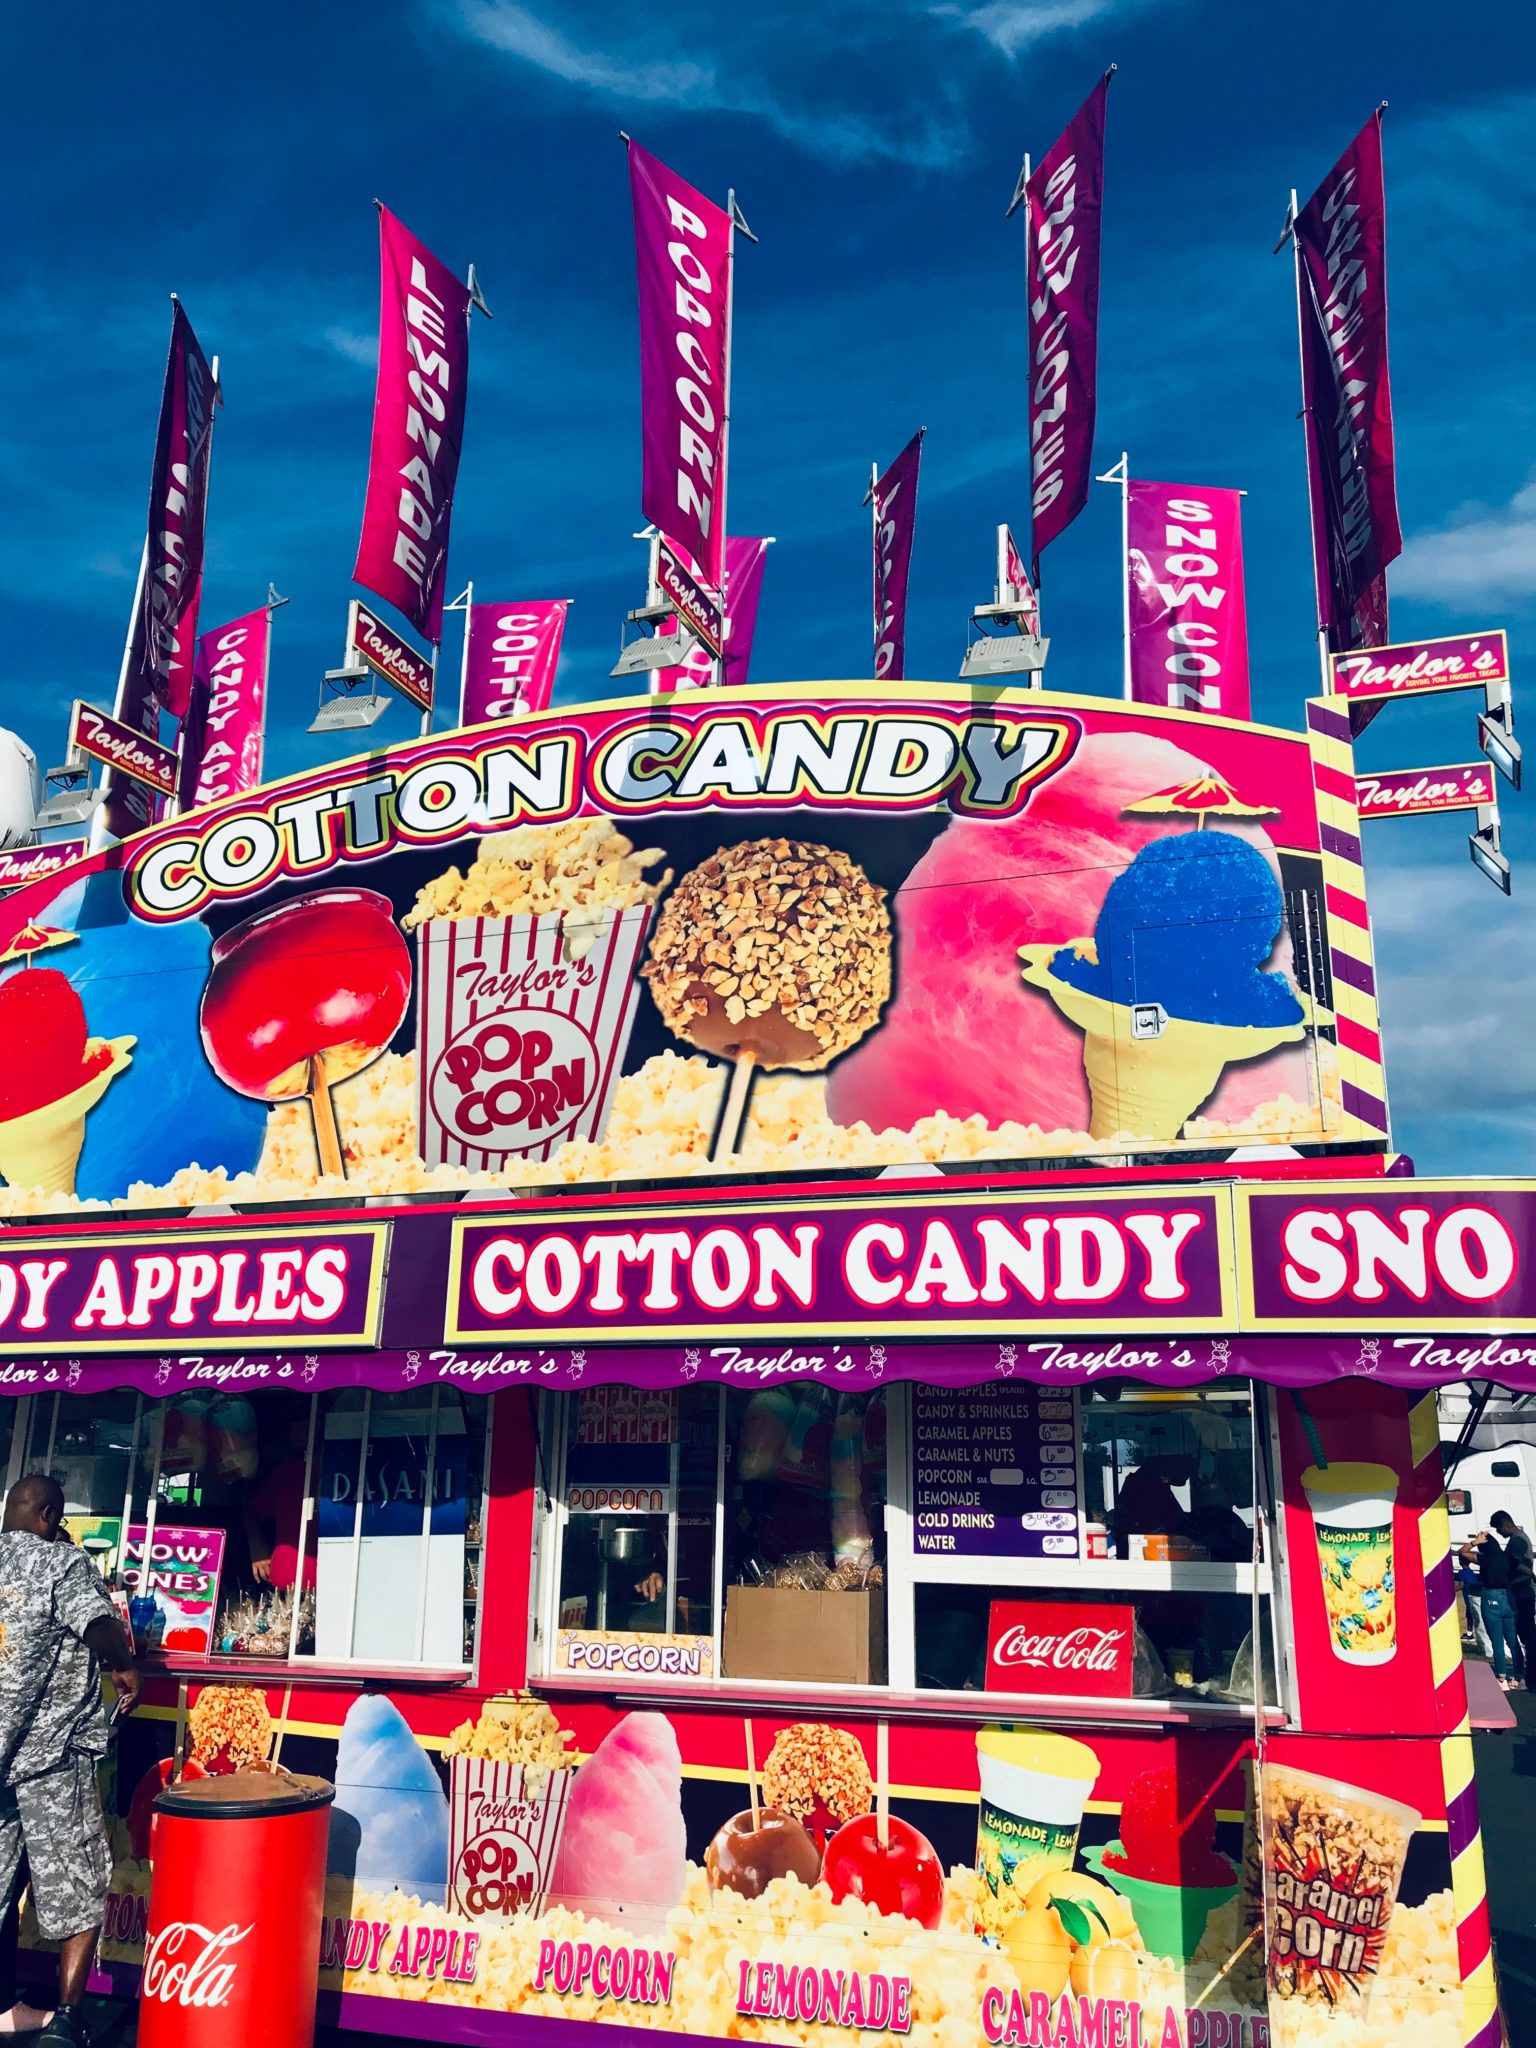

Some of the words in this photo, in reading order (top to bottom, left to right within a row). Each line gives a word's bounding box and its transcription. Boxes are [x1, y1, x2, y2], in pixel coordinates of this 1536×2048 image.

[1031, 154, 1081, 324] SNOW
[1322, 167, 1367, 376] CARAMEL
[667, 194, 716, 540] POPCORN
[392, 255, 450, 584] LEMONADE
[1031, 311, 1070, 519] CONES
[1158, 499, 1227, 610] SNOW
[660, 548, 719, 639] Taylor's
[358, 612, 430, 692] Taylor's
[1337, 641, 1497, 689] Taylor's
[206, 628, 249, 732] CANDY
[81, 710, 172, 780] Taylor's
[193, 740, 236, 809] APP
[1356, 769, 1487, 809] Taylor's
[138, 741, 567, 911] COTTON
[602, 719, 1057, 804] CANDY
[456, 960, 598, 1005] Taylor's
[444, 1024, 553, 1095] POP
[454, 1057, 586, 1136] CORN
[472, 1225, 819, 1315] COTTON
[845, 1213, 1200, 1305] CANDY
[1284, 1208, 1514, 1300] SNO
[74, 1248, 347, 1328] APPLES
[0, 1361, 60, 1383] lor's
[179, 1355, 294, 1384] Taylor's
[428, 1350, 559, 1381] Taylor's
[710, 1346, 856, 1377] Taylor's
[1027, 1340, 1196, 1376] Taylor's
[917, 1404, 955, 1419] CANDY
[958, 1405, 968, 1419] &
[969, 1404, 1029, 1419] SPRINKLES
[958, 1383, 998, 1398] APPLES
[917, 1426, 969, 1441] CARAMEL
[972, 1426, 1012, 1441] APPLES
[917, 1447, 970, 1462] CARAMEL
[972, 1448, 982, 1462] &
[984, 1447, 1015, 1462] NUTS
[331, 1462, 452, 1510] DASANI
[568, 1488, 663, 1511] POPCORN
[918, 1468, 972, 1484] POPCORN
[918, 1490, 981, 1506] LEMONADE
[917, 1513, 950, 1528] COLD
[952, 1513, 995, 1529] DRINKS
[918, 1534, 956, 1550] WATER
[1320, 1529, 1370, 1544] LEMONADE
[568, 1642, 700, 1674] POPCORN
[993, 1624, 1127, 1671] Coca-Cola
[470, 1791, 542, 1826] Taylor's
[985, 1810, 1047, 1843] LEMONADE
[463, 1838, 517, 1886] POP
[466, 1872, 534, 1916] CORN
[1276, 1872, 1382, 1928] aramel
[389, 1924, 480, 1983] APPLE
[534, 1939, 675, 2005] POPCORN
[735, 1960, 912, 2033] LEMONADE
[981, 1985, 1148, 2048] CARAMEL
